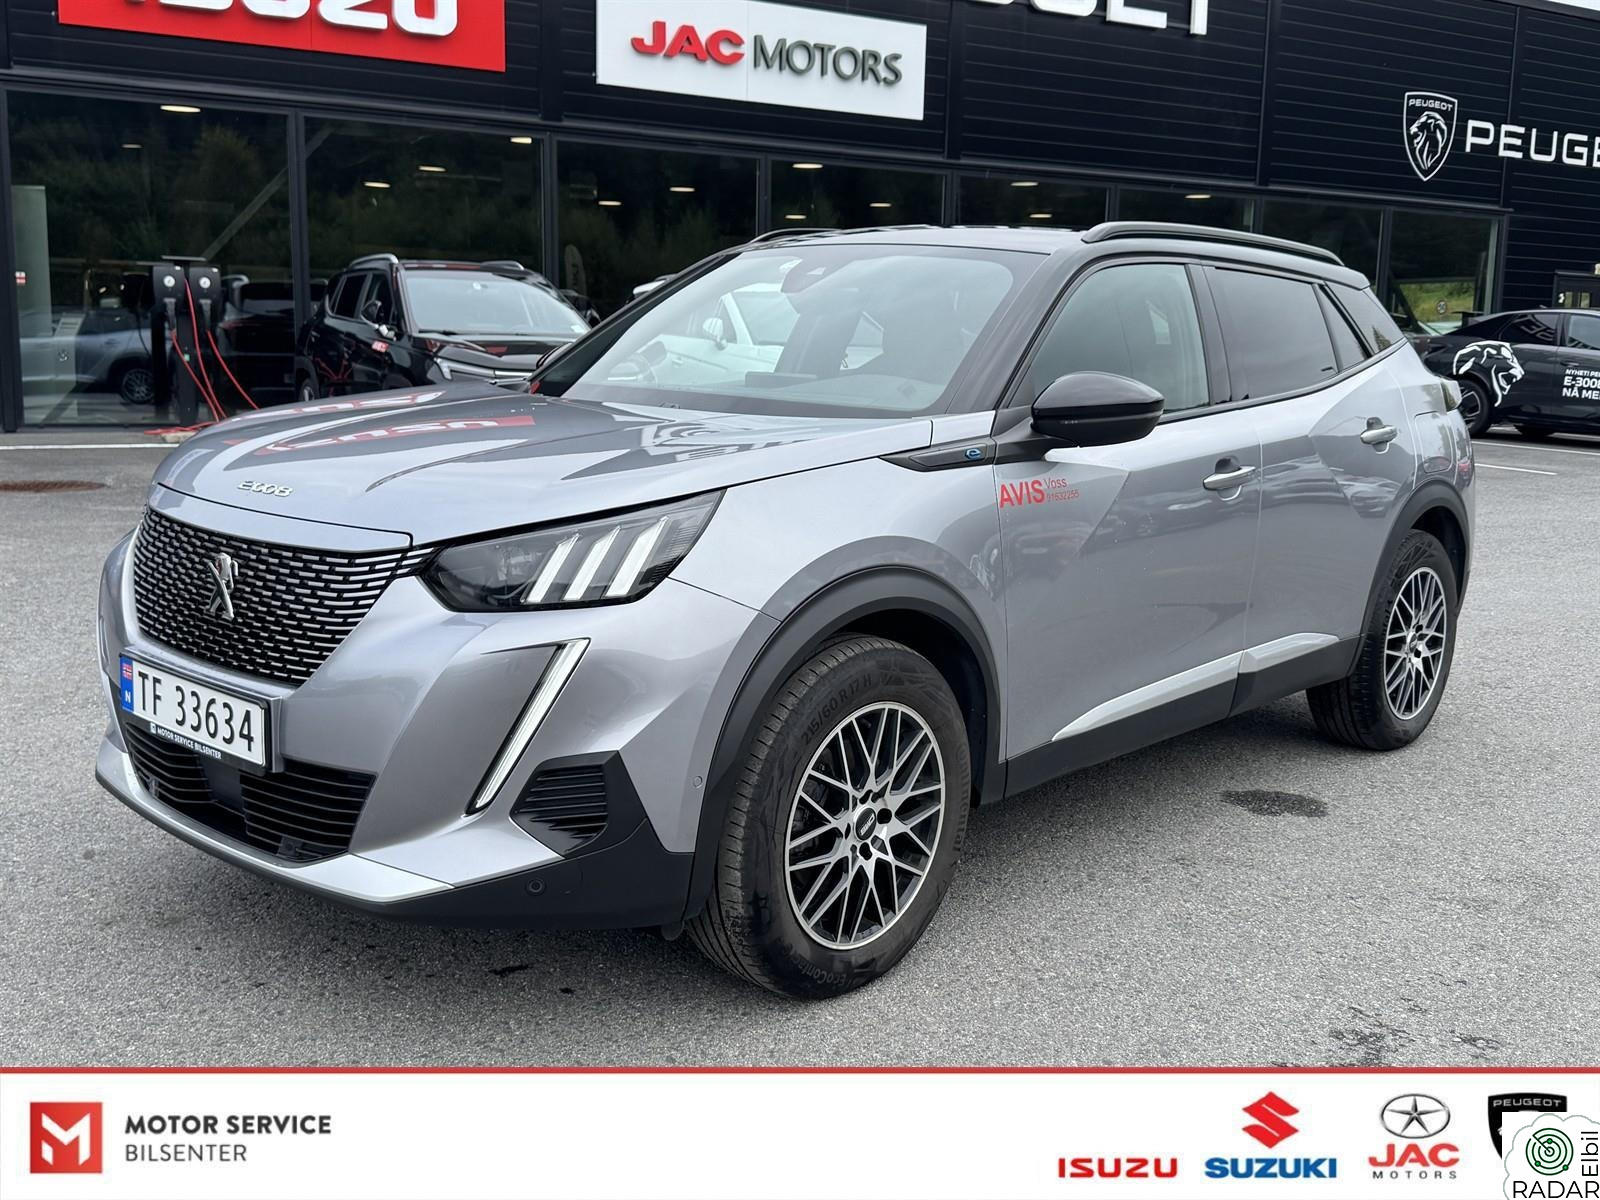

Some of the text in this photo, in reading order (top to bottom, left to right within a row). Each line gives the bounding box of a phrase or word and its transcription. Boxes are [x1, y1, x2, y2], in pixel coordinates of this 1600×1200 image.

[631, 21, 903, 86] JAC MOTORS
[1408, 99, 1453, 112] PEUGEOT
[1465, 119, 1600, 168] PEUG
[1562, 387, 1600, 400] NÅ ME
[999, 479, 1045, 508] AVIS
[1043, 478, 1068, 490] Voss
[124, 690, 132, 703] N
[138, 670, 254, 753] TF 33634
[801, 697, 838, 746] 215/60
[157, 726, 222, 760] MOTOR SERVICE BILSENTER
